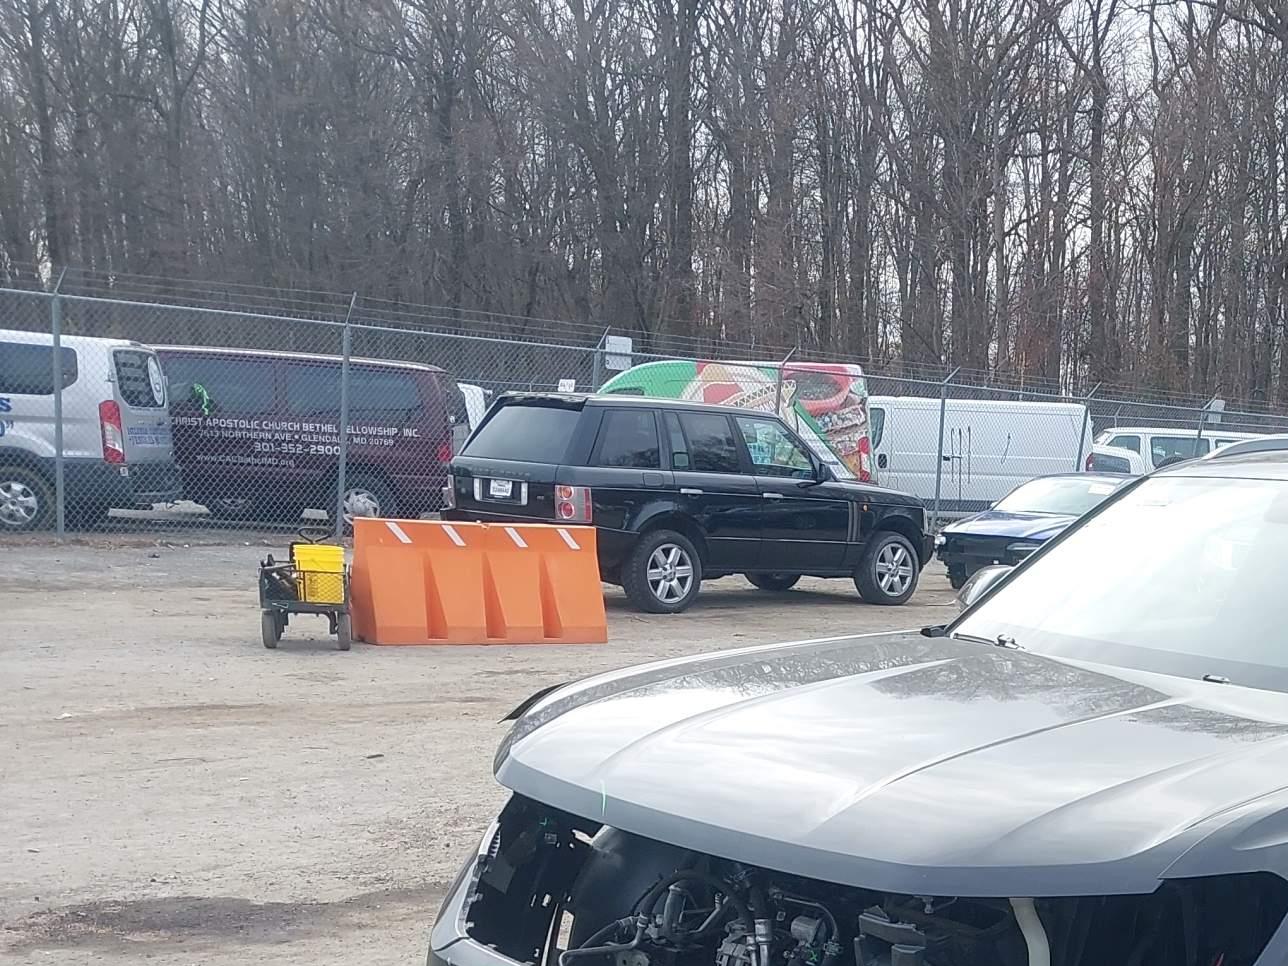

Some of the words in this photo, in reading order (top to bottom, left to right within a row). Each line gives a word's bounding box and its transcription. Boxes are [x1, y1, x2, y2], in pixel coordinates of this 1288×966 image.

[205, 418, 259, 429] APOSTOLIC
[262, 420, 300, 431] CHURCH
[302, 423, 337, 433] BETHEL
[345, 425, 400, 436] ELLOWSHIP,
[221, 431, 272, 440] NORTHERN
[353, 437, 367, 445] MD
[254, 442, 341, 455] 301-352-2900
